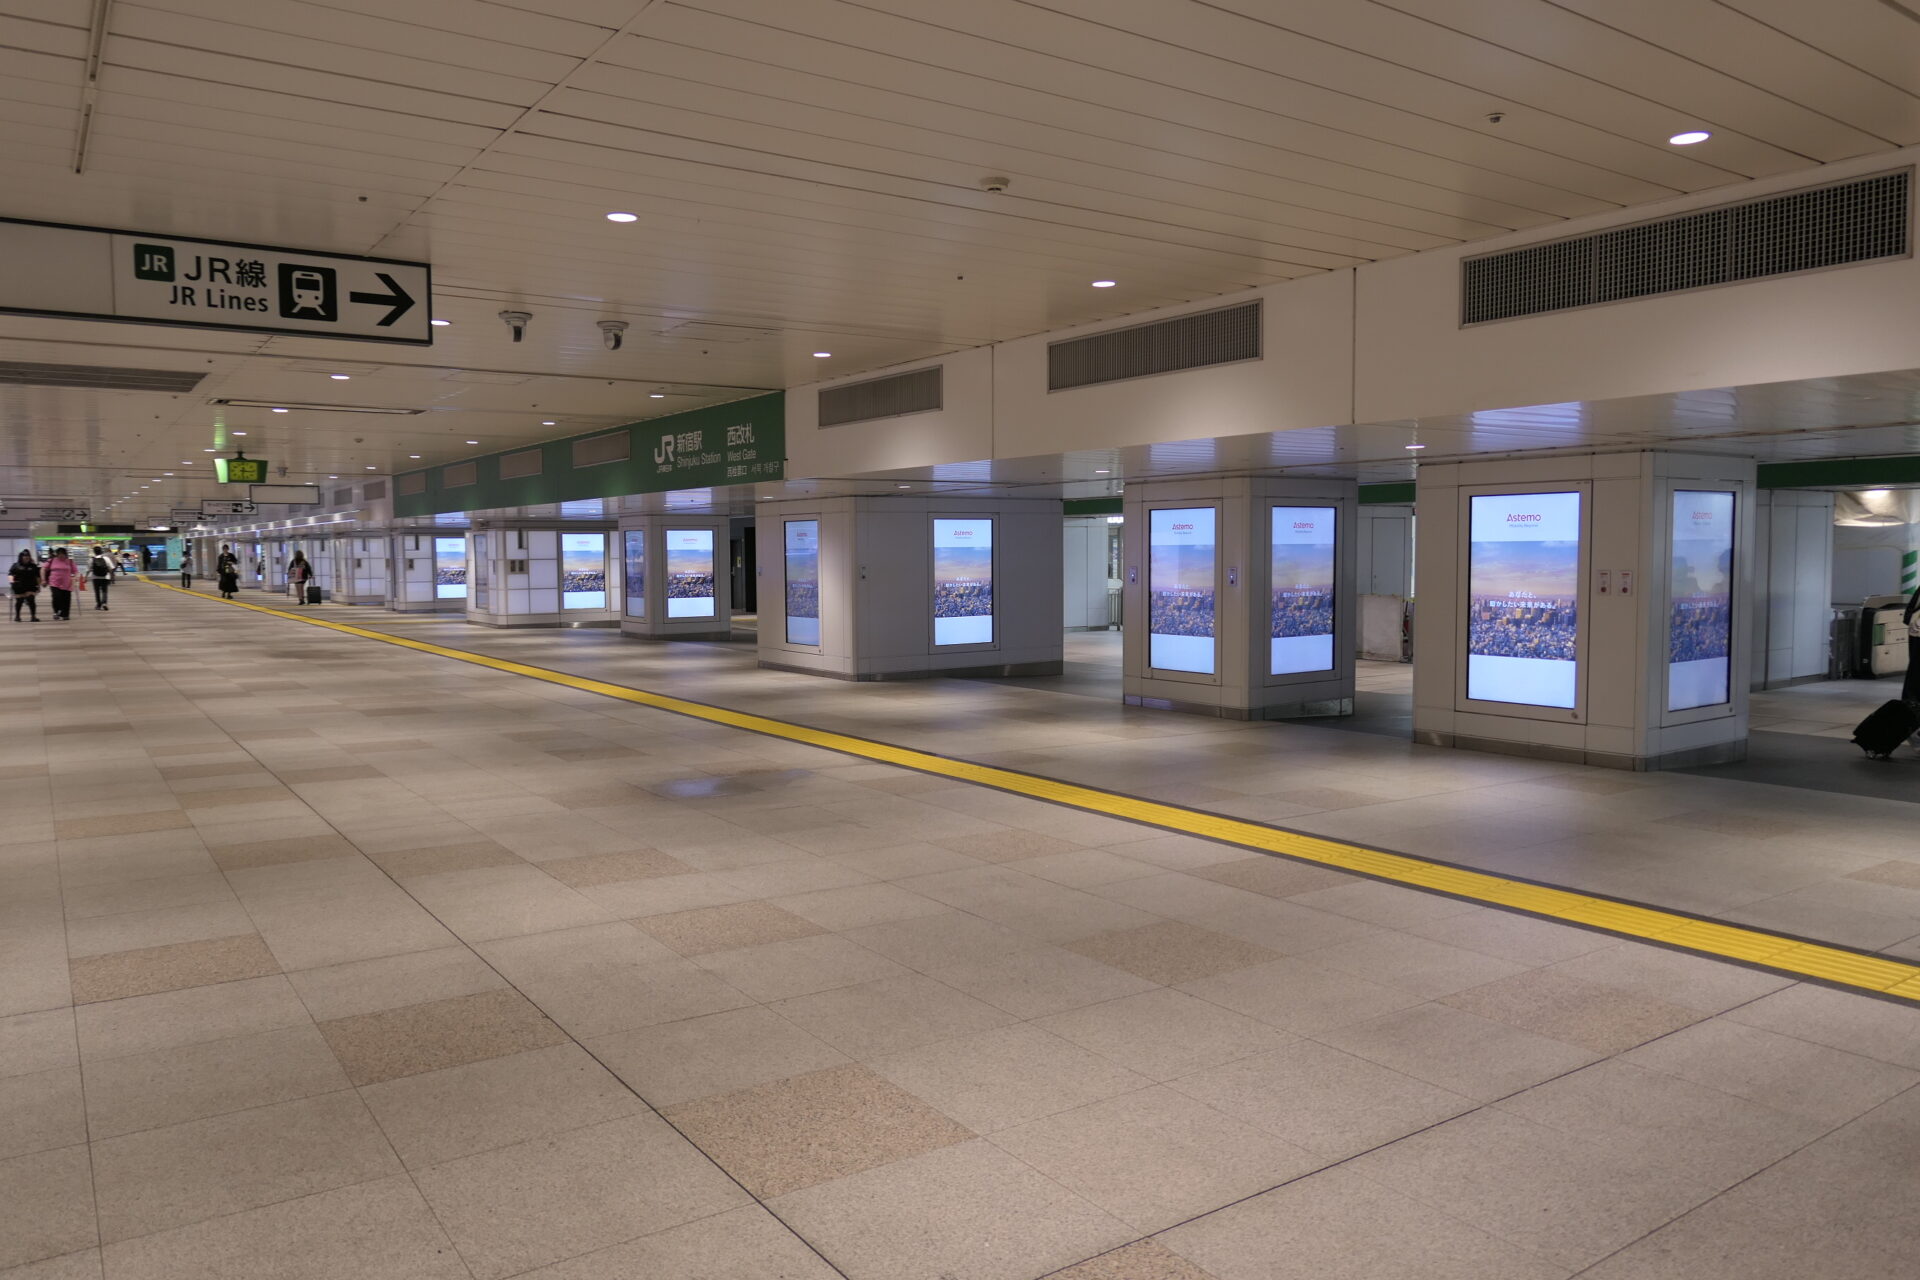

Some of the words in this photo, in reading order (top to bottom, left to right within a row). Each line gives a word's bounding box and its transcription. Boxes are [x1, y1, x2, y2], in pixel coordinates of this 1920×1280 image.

[141, 254, 168, 272] JR
[184, 256, 267, 287] JR線
[169, 285, 197, 307] JR
[206, 288, 269, 313] Lines
[677, 431, 702, 453] 新宿駅
[727, 423, 755, 446] 西改札
[654, 434, 675, 464] JR
[727, 450, 741, 462] West
[742, 449, 757, 460] Gate
[677, 456, 701, 469] Shinjuku
[701, 453, 720, 464] Station
[1506, 513, 1542, 522] Astemo
